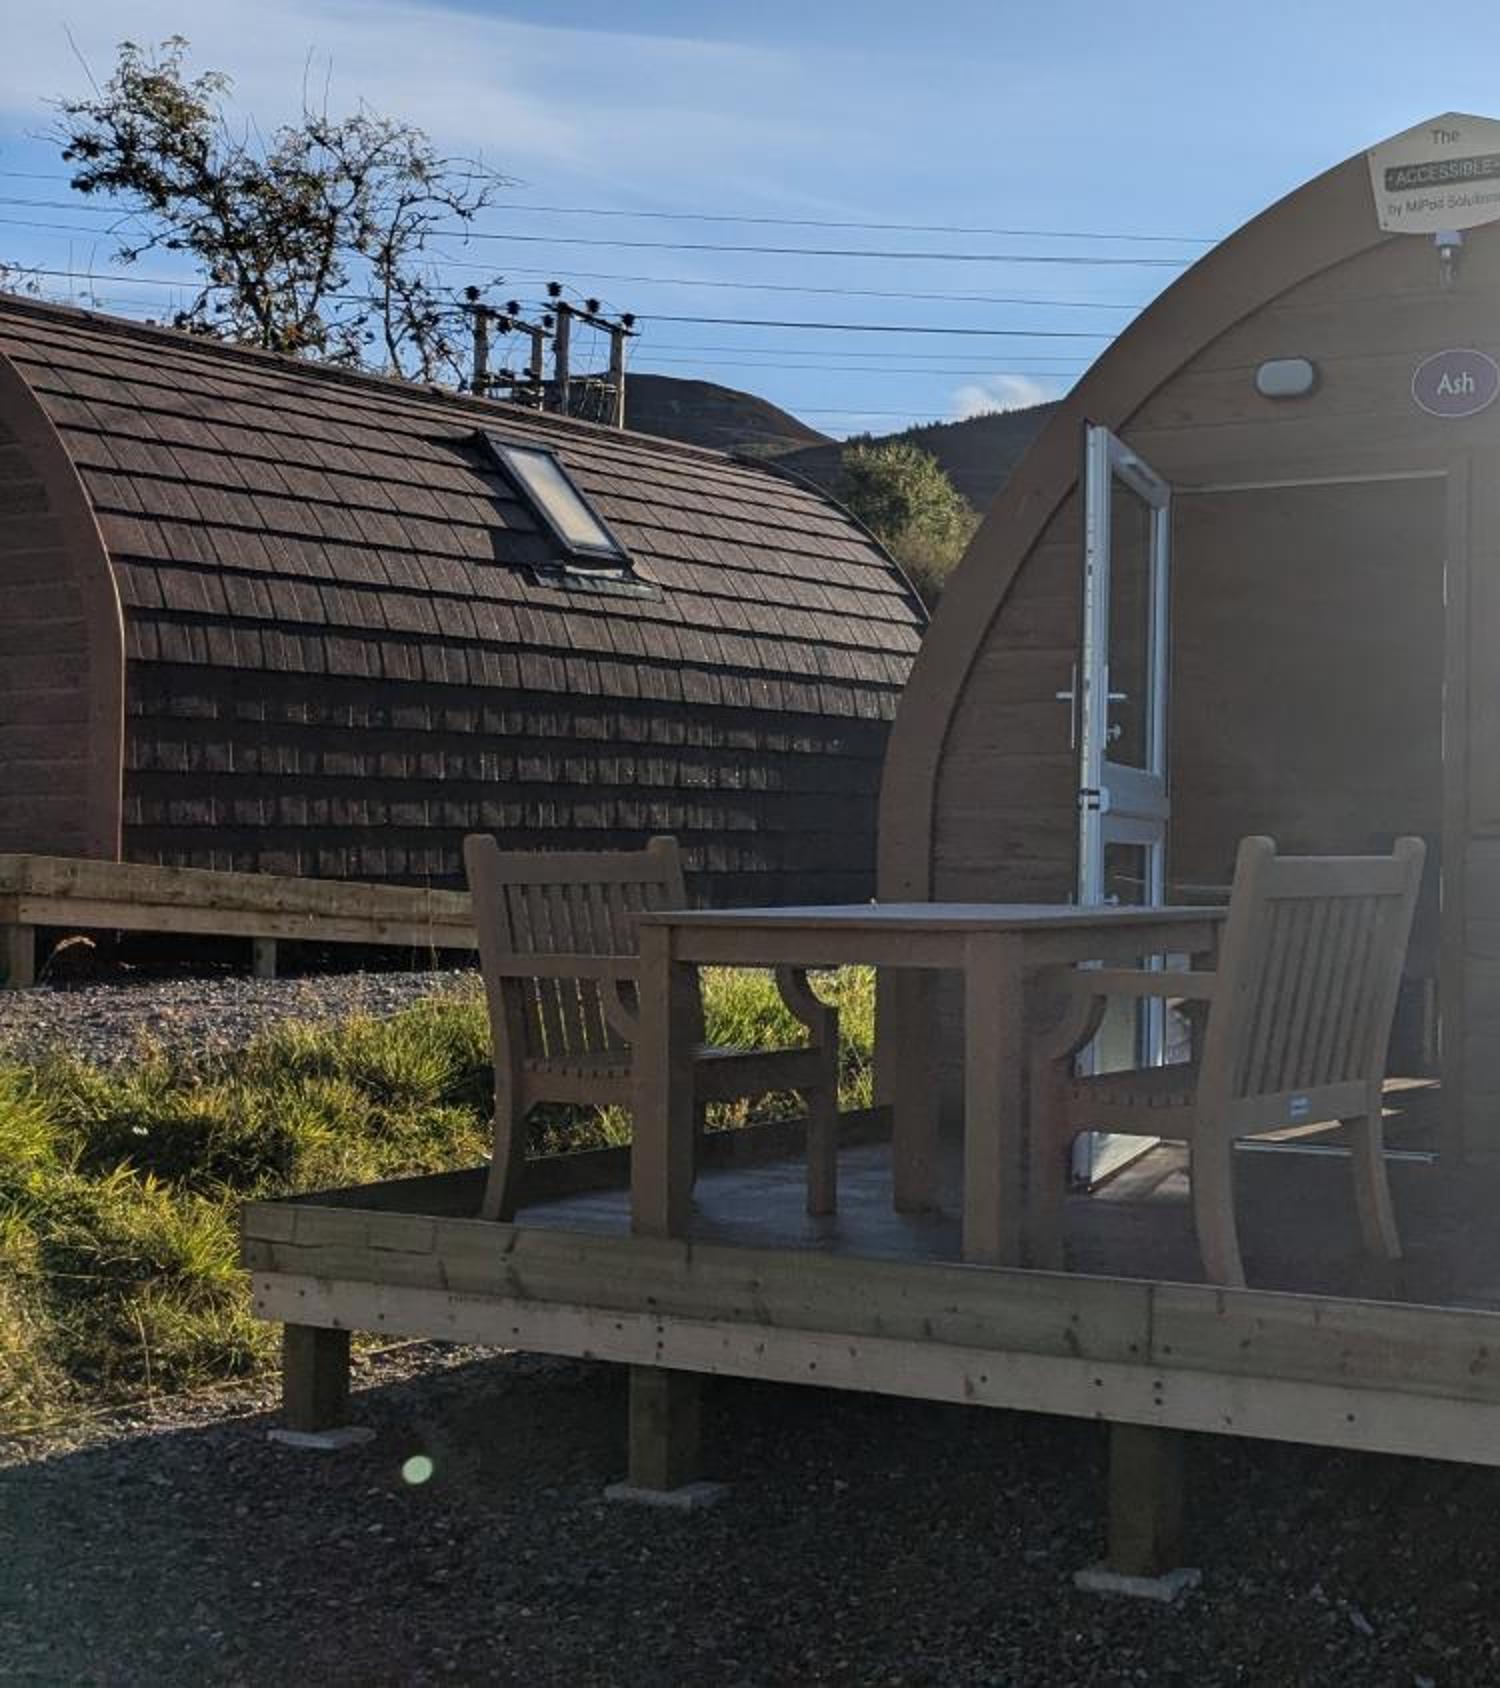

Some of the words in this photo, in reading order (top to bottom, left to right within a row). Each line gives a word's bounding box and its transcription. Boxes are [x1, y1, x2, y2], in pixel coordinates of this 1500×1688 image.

[1430, 129, 1461, 145] The
[1388, 204, 1402, 216] by
[1437, 371, 1474, 395] Ash
